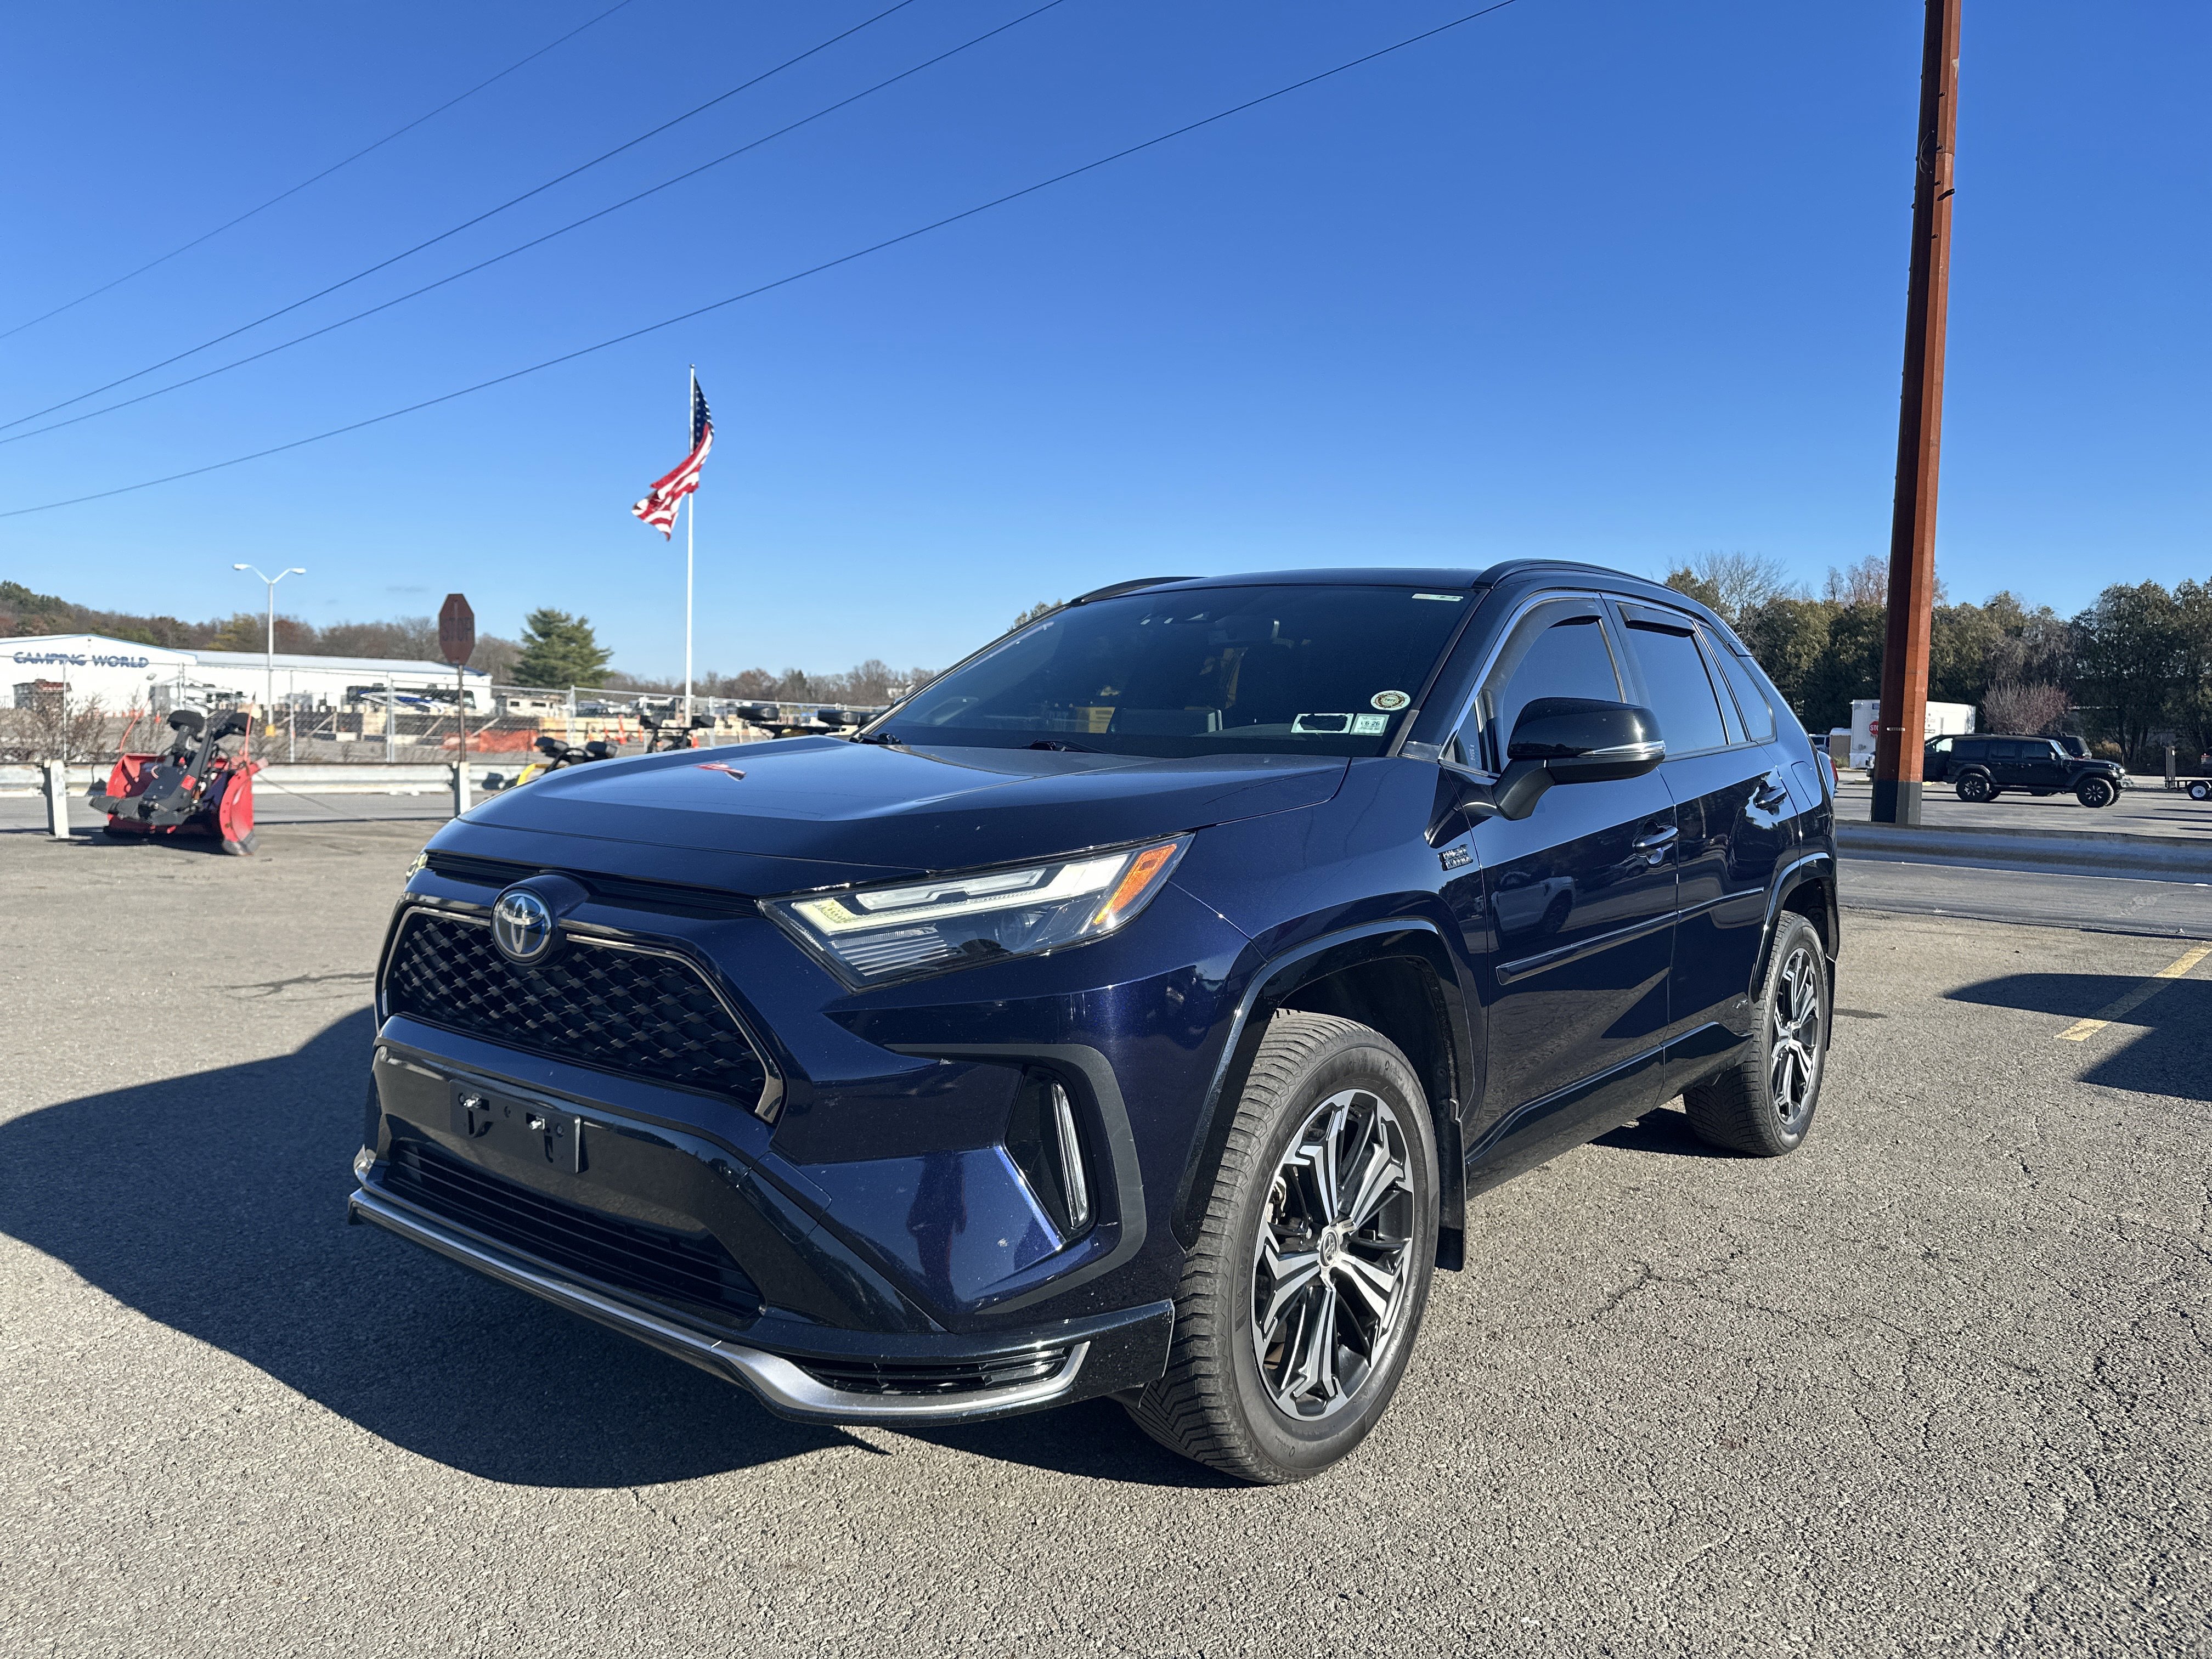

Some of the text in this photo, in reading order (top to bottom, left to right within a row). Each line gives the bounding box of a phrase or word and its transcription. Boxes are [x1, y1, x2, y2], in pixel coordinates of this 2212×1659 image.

[441, 617, 472, 641] STOP
[14, 652, 149, 668] CAMPING WORLD
